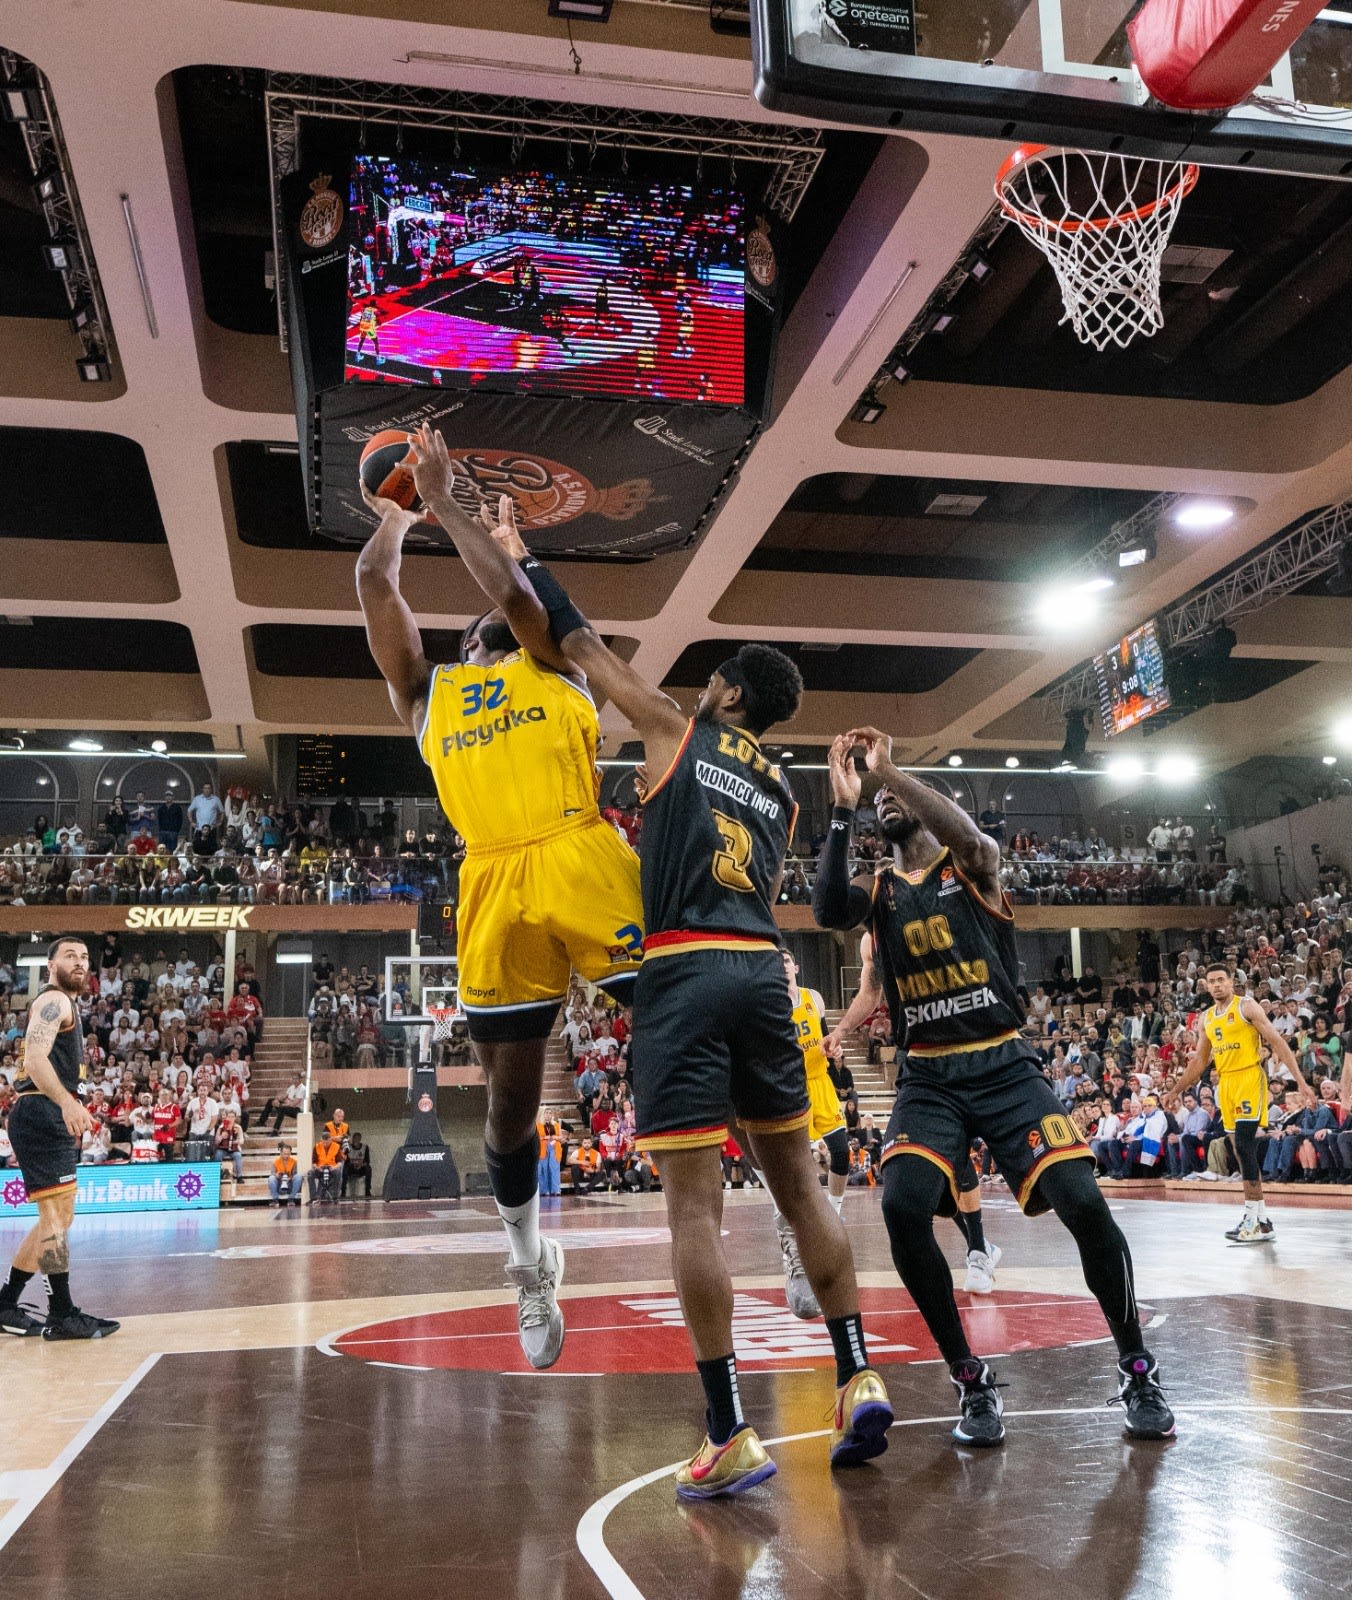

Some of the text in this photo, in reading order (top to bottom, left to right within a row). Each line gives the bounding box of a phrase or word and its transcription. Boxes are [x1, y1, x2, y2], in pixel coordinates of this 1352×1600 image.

[850, 9, 910, 24] oneteam
[393, 411, 424, 424] Louis
[422, 403, 437, 413] II
[1132, 642, 1139, 657] 0
[1111, 655, 1118, 671] 3
[1122, 674, 1139, 694] 9:08
[461, 677, 508, 717] 32
[697, 763, 779, 820] MONACO INFO
[1124, 825, 1134, 840] S
[711, 808, 756, 893] 3
[125, 905, 255, 928] SKWEEK
[902, 914, 954, 957] 00
[466, 986, 496, 998] Rapyd
[904, 986, 999, 1028] SKWEEK
[1241, 1101, 1253, 1115] 5
[404, 1152, 446, 1163] SKWEEK
[76, 1178, 168, 1204] nizBank
